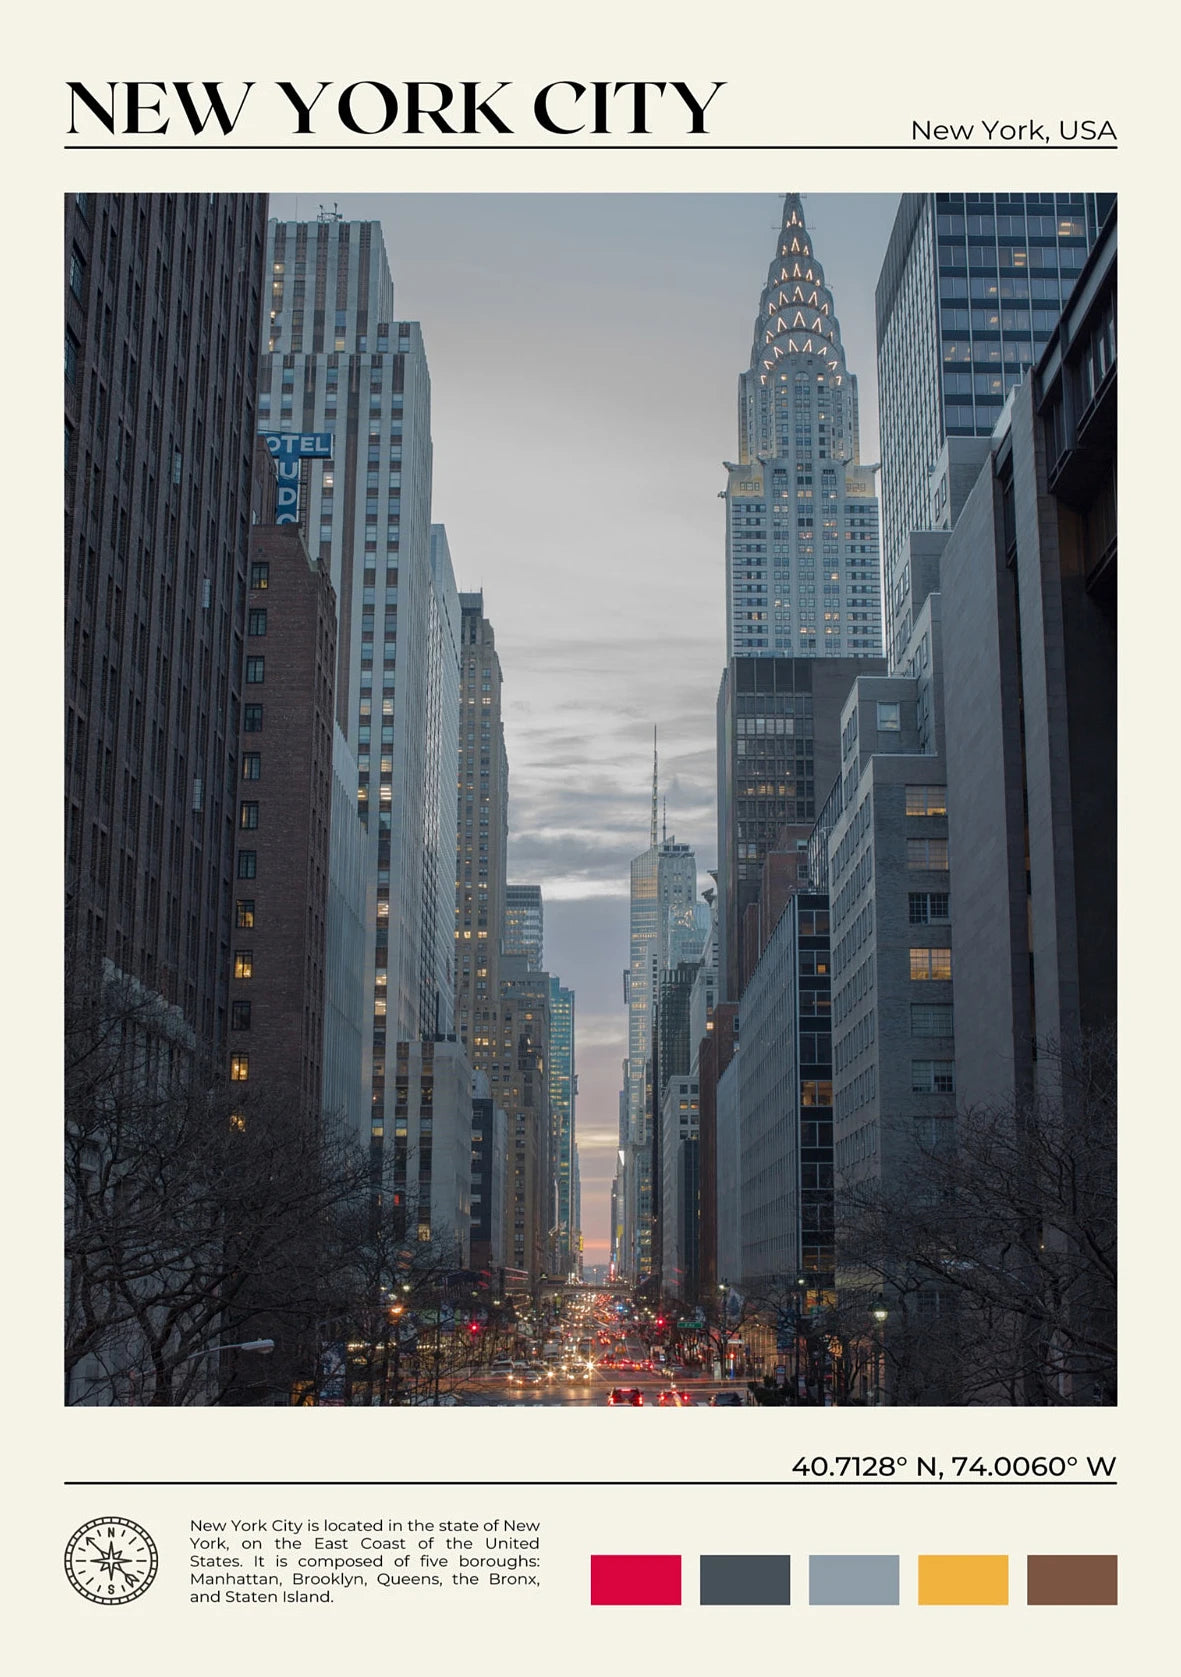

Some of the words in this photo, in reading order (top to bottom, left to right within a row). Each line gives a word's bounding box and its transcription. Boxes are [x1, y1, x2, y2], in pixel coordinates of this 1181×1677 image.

[65, 82, 256, 136] NEW
[275, 81, 514, 134] YORK
[534, 81, 728, 134] CITY
[913, 121, 974, 140] New
[981, 119, 1049, 144] York,
[1060, 120, 1117, 140] USA
[792, 1457, 907, 1476] 40.7128°
[918, 1457, 943, 1480] N,
[952, 1457, 1077, 1476] 74.0060°
[1087, 1457, 1116, 1476] W
[108, 1527, 115, 1538] N
[191, 1520, 226, 1531] New
[231, 1520, 267, 1531] York
[272, 1519, 303, 1534] City
[308, 1520, 319, 1531] is
[325, 1519, 382, 1531] located
[389, 1519, 402, 1531] in
[408, 1520, 434, 1531] the
[439, 1521, 478, 1531] state
[484, 1519, 499, 1531] of
[505, 1520, 540, 1531] New
[190, 1537, 229, 1551] York,
[242, 1540, 261, 1549] on
[275, 1537, 301, 1549] the
[315, 1538, 348, 1549] East
[361, 1538, 405, 1549] Coast
[418, 1537, 434, 1549] of
[446, 1537, 472, 1549] the
[486, 1537, 539, 1549] United
[191, 1555, 242, 1567] States.
[255, 1556, 264, 1567] It
[277, 1555, 287, 1567] is
[298, 1555, 382, 1570] composed
[394, 1555, 410, 1567] of
[420, 1555, 448, 1567] five
[460, 1555, 540, 1570] boroughs:
[191, 1573, 282, 1586] Manhattan,
[293, 1573, 367, 1588] Brooklyn,
[377, 1573, 442, 1587] Queens,
[452, 1573, 478, 1585] the
[490, 1573, 539, 1586] Bronx,
[108, 1584, 115, 1595] S
[191, 1590, 220, 1602] and
[226, 1591, 277, 1602] Staten
[284, 1590, 333, 1602] Island.
